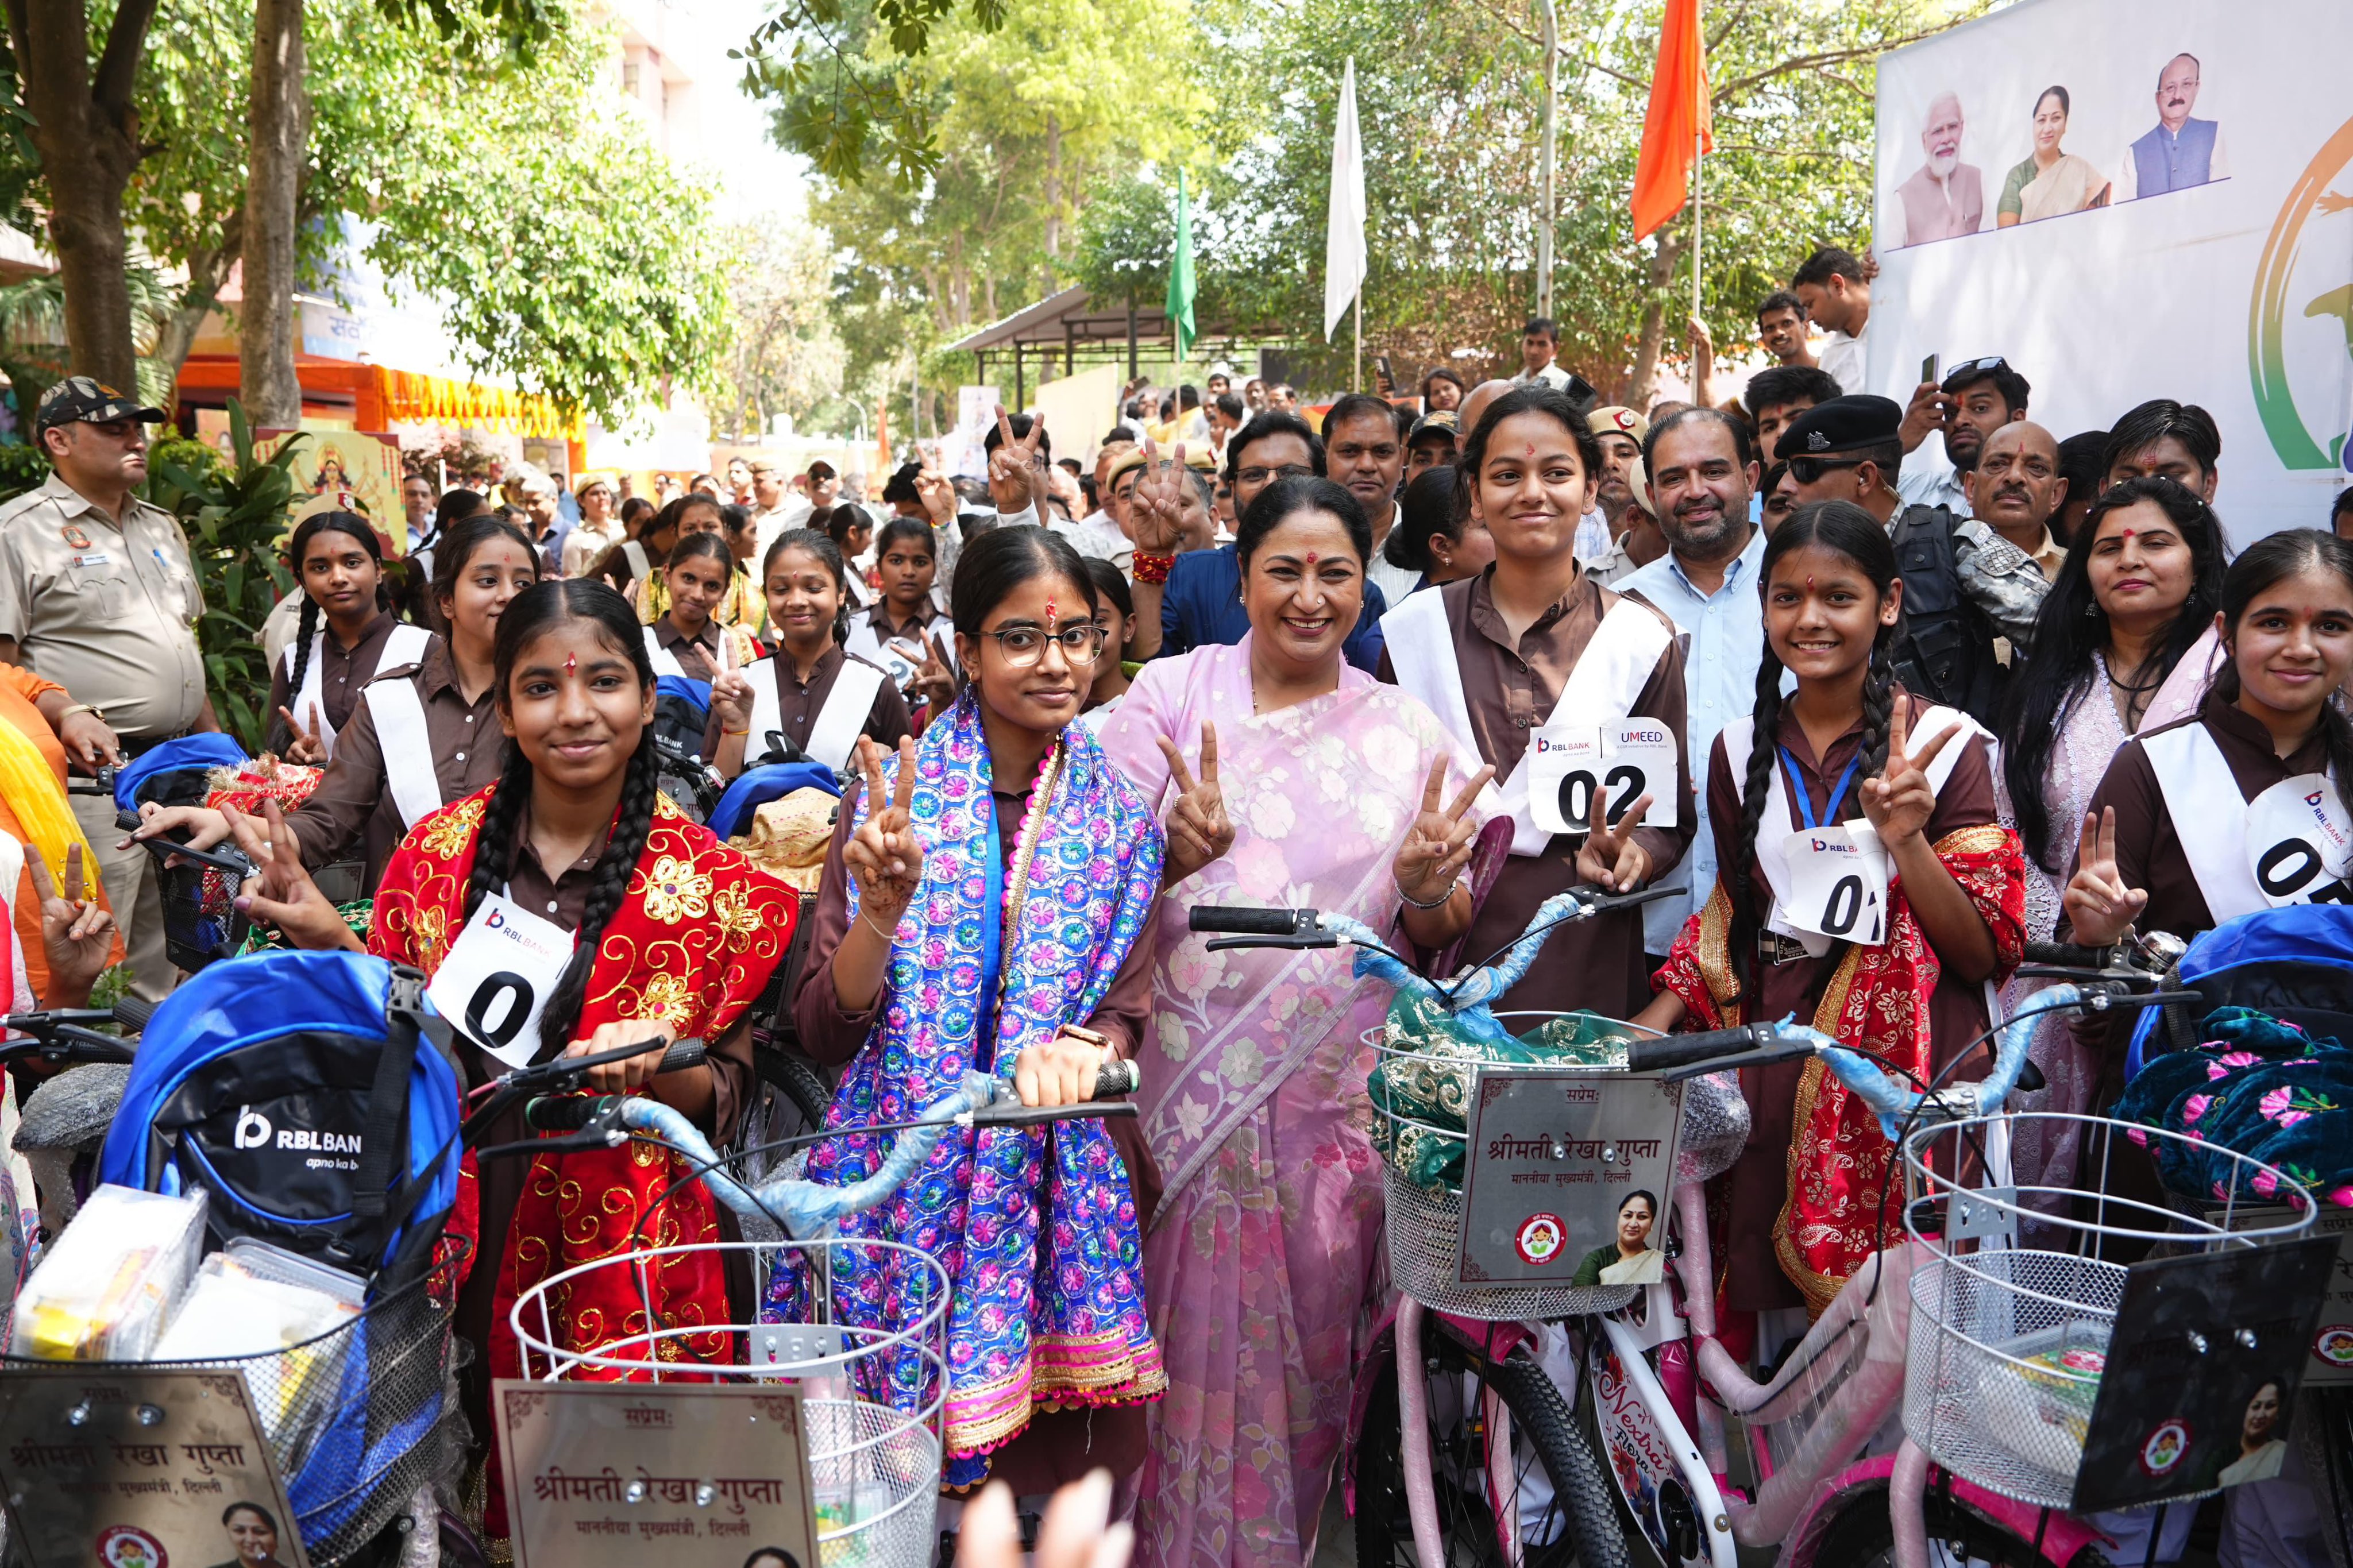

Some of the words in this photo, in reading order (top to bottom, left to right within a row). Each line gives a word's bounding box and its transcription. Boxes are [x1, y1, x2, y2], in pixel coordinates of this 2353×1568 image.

[1621, 731, 1662, 743] UMEED
[1558, 766, 1646, 831] 02
[1488, 1133, 1553, 1160] श्रीमती
[1564, 1132, 1606, 1160] रेखा
[1615, 1140, 1661, 1167] गुप्ता
[1511, 1171, 1550, 1184] माननीया
[1603, 1169, 1631, 1184] दिल्ली
[1599, 1374, 1665, 1470] Nextra
[106, 1435, 169, 1466] रेखा
[179, 1444, 246, 1474] गुप्ता
[1615, 1424, 1650, 1474] Flora
[534, 1466, 623, 1501] श्रीमती
[635, 1466, 699, 1503] रेखा
[715, 1478, 784, 1515] गुप्ता
